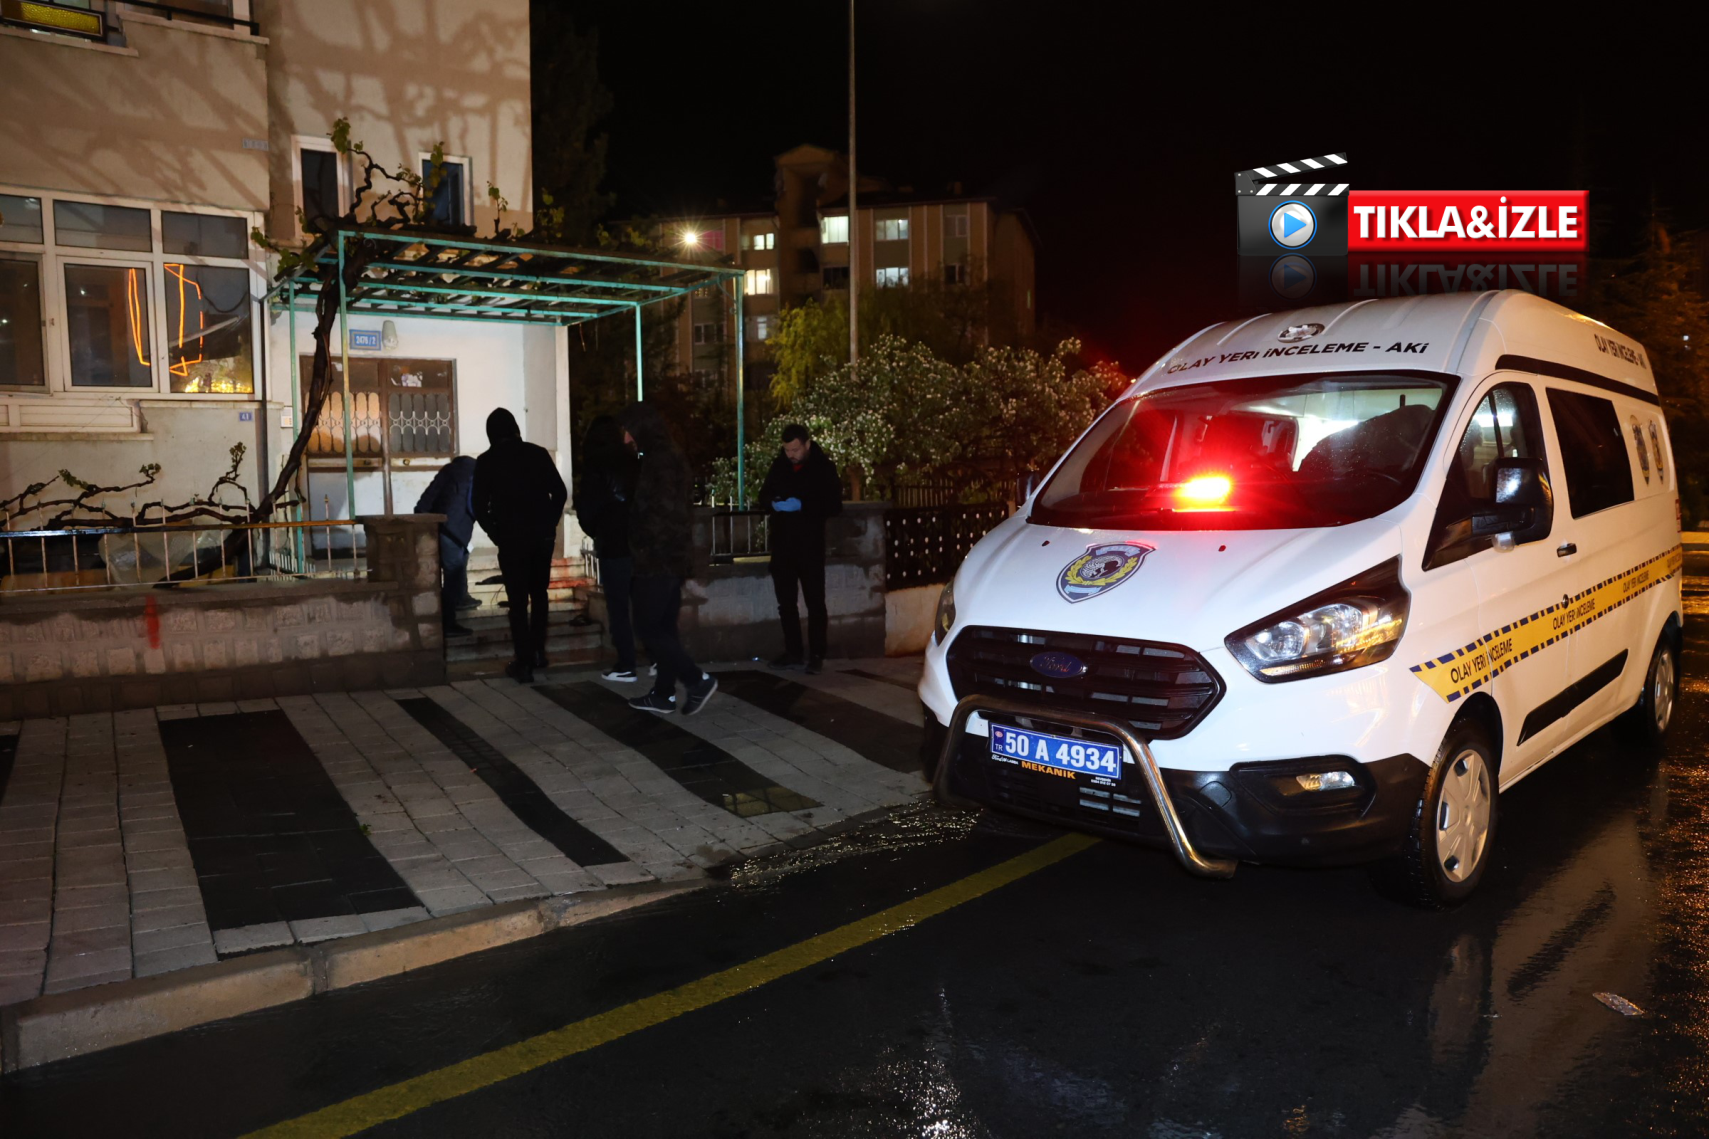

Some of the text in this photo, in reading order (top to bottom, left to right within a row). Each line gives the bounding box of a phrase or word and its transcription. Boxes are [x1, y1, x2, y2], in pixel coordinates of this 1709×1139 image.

[1167, 356, 1216, 374] OLAY
[1450, 660, 1472, 684] OLAY
[995, 743, 1003, 752] TR
[1005, 731, 1030, 757] 50
[1035, 738, 1050, 761] A
[1055, 742, 1117, 773] 4934
